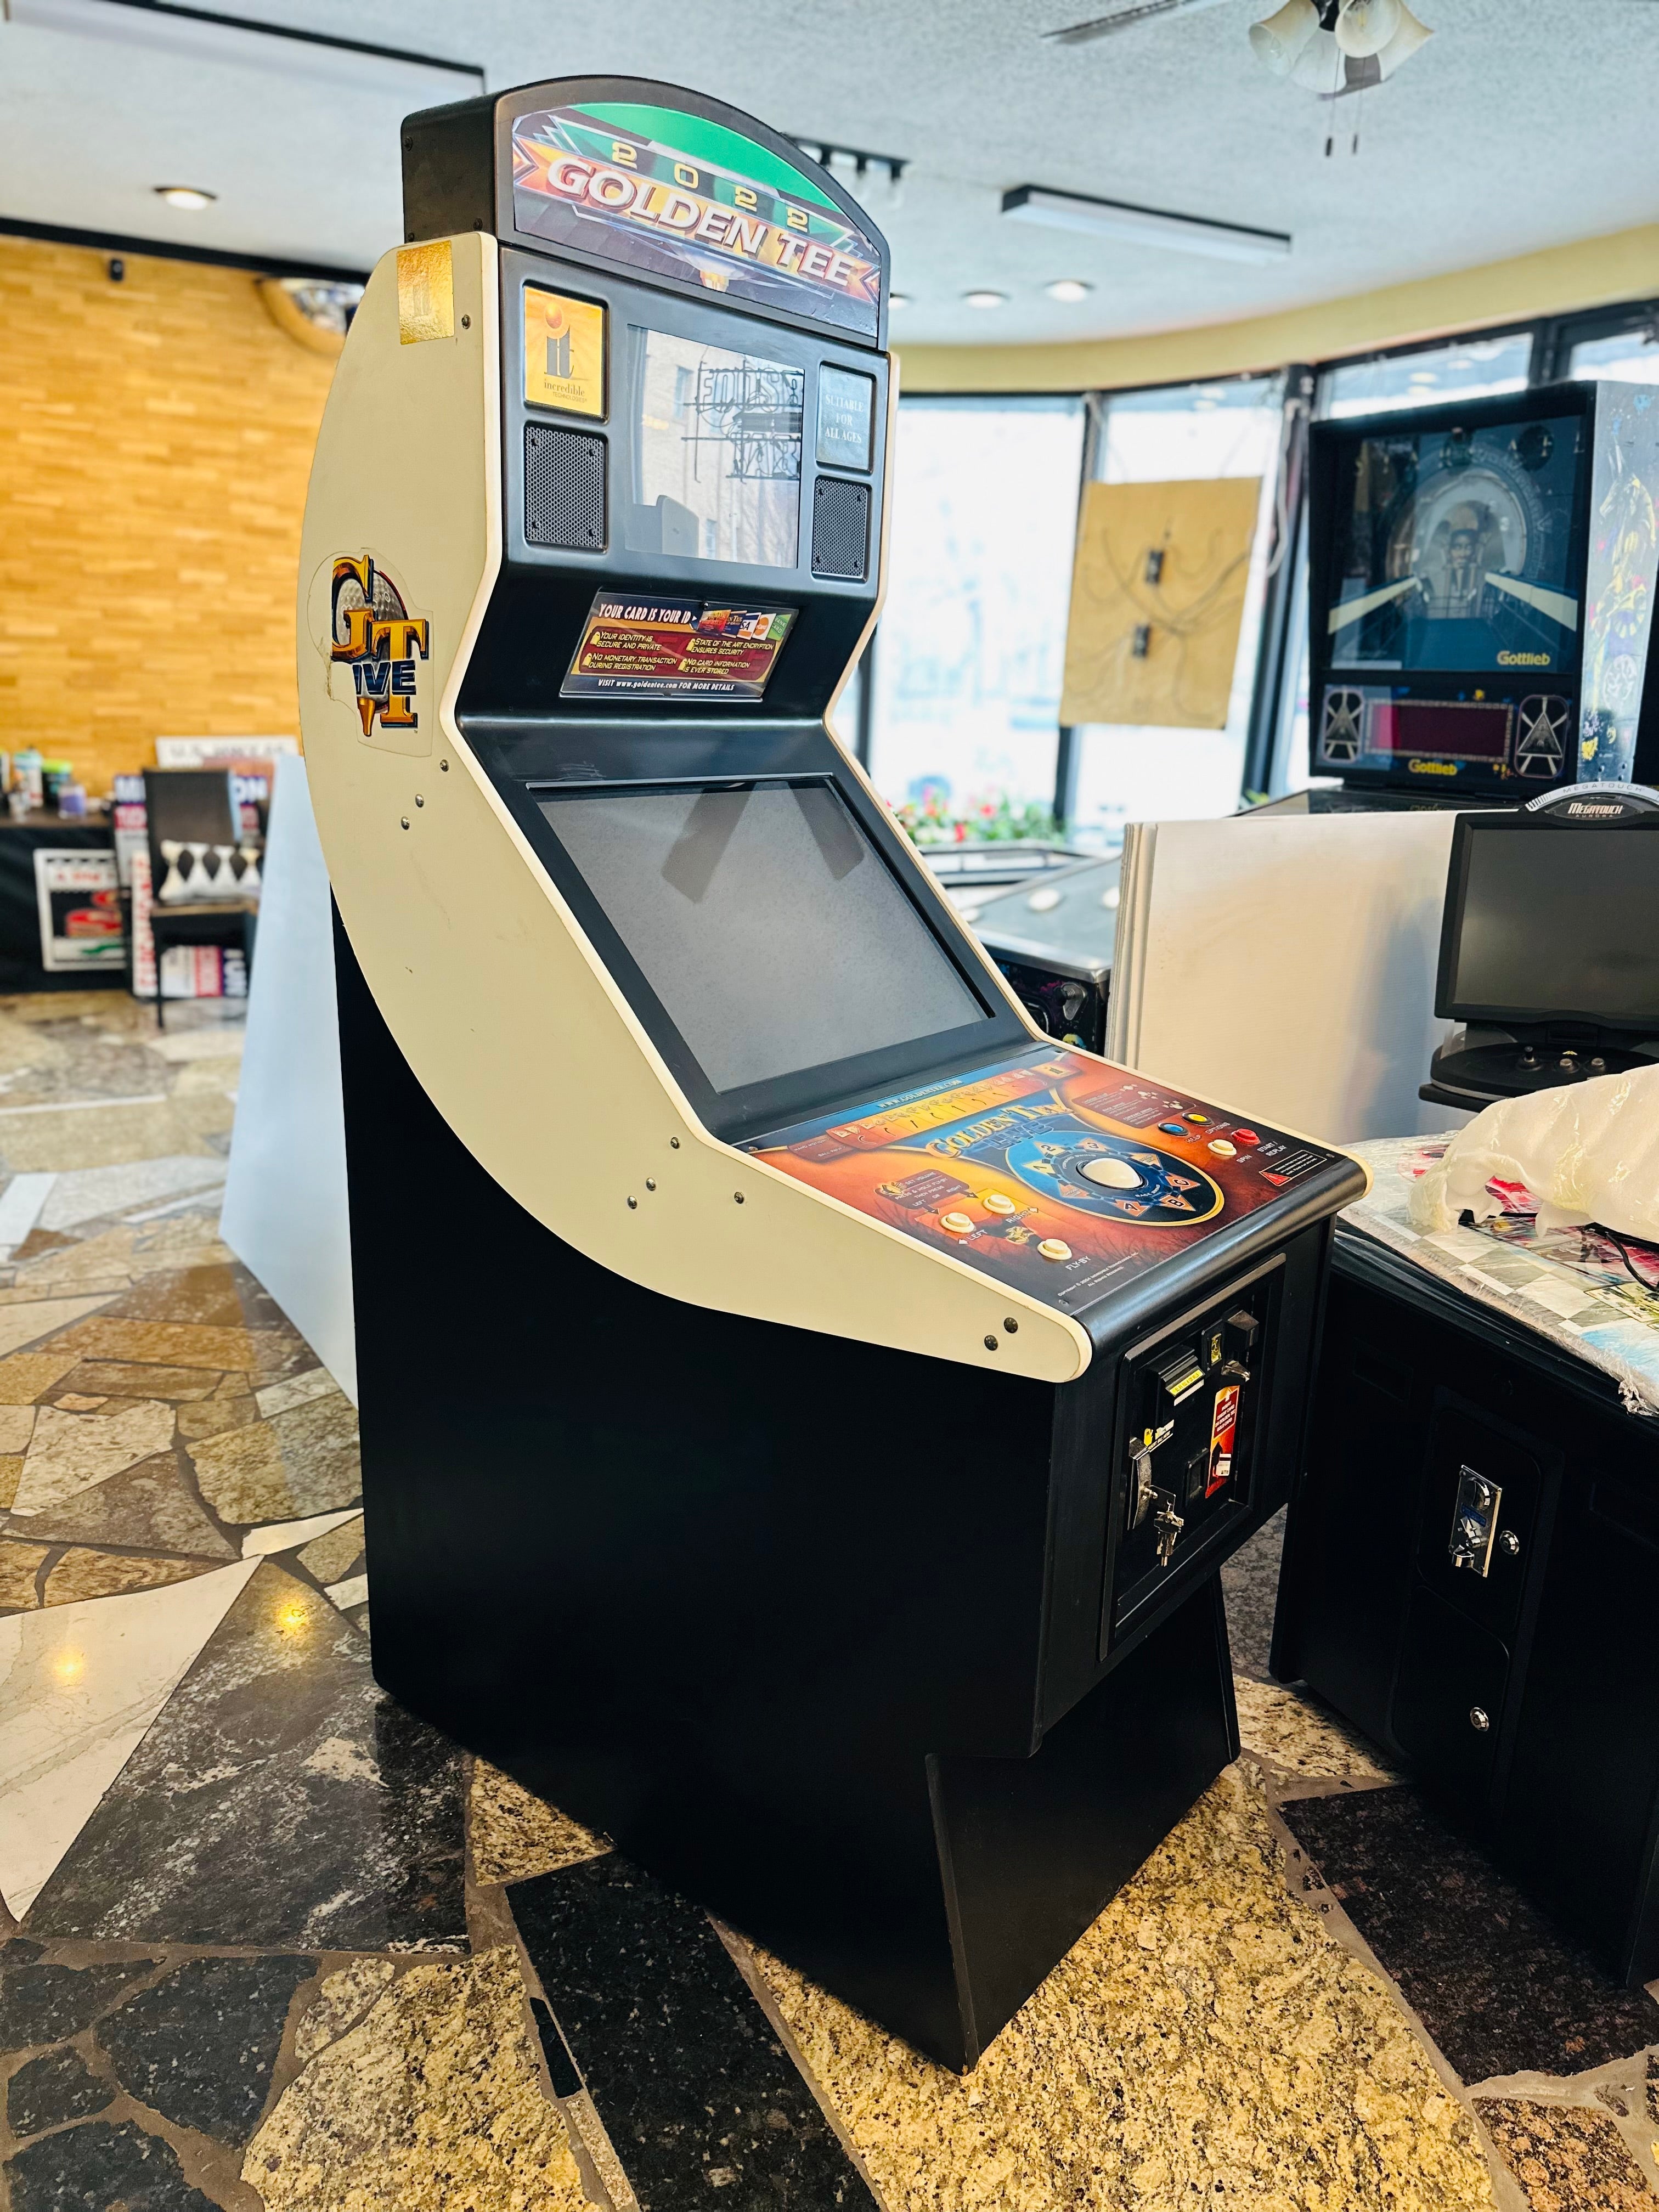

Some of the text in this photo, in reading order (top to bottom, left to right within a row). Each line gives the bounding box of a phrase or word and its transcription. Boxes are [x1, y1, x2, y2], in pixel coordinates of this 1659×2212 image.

[547, 156, 854, 286] GOLDEN TEE
[544, 379, 585, 397] incredible
[825, 394, 864, 413] SUITABLE
[836, 413, 853, 426] FOR
[825, 427, 862, 443] ALL AGES
[599, 603, 624, 618] YOUR
[624, 606, 648, 621] CARD
[647, 608, 658, 622] IS
[658, 609, 681, 624] YOUR
[681, 611, 691, 624] ID
[741, 622, 751, 630] SA
[774, 617, 787, 628] BANK
[600, 631, 618, 640] YOUR
[618, 633, 646, 642] IDENTITY
[695, 638, 712, 646] STATE
[596, 640, 623, 648] SECURE
[636, 643, 662, 651] PRIVATE
[592, 652, 603, 661] NO
[637, 657, 678, 665] TRANSACTION
[1497, 650, 1551, 665] Gottlieb
[613, 663, 656, 671] REGISTRATION
[352, 659, 416, 695] IVE
[616, 680, 677, 689] www.goldentee.com
[1408, 758, 1458, 776] Gottlieb
[1563, 783, 1643, 793] MEGATOUCH
[1567, 803, 1624, 814] MEGATOUCH
[1205, 1122, 1231, 1135] OPTIONS
[925, 1113, 1023, 1158] GOLDEN
[988, 1121, 1054, 1150] LIVE
[1185, 1133, 1202, 1144] HELP
[1257, 1142, 1274, 1153] START
[1265, 1144, 1288, 1157] REPLAY
[1235, 1154, 1253, 1164] SPIN
[1167, 1199, 1184, 1207] B
[1006, 1210, 1031, 1223] RIGHT
[966, 1229, 988, 1241] LEFT
